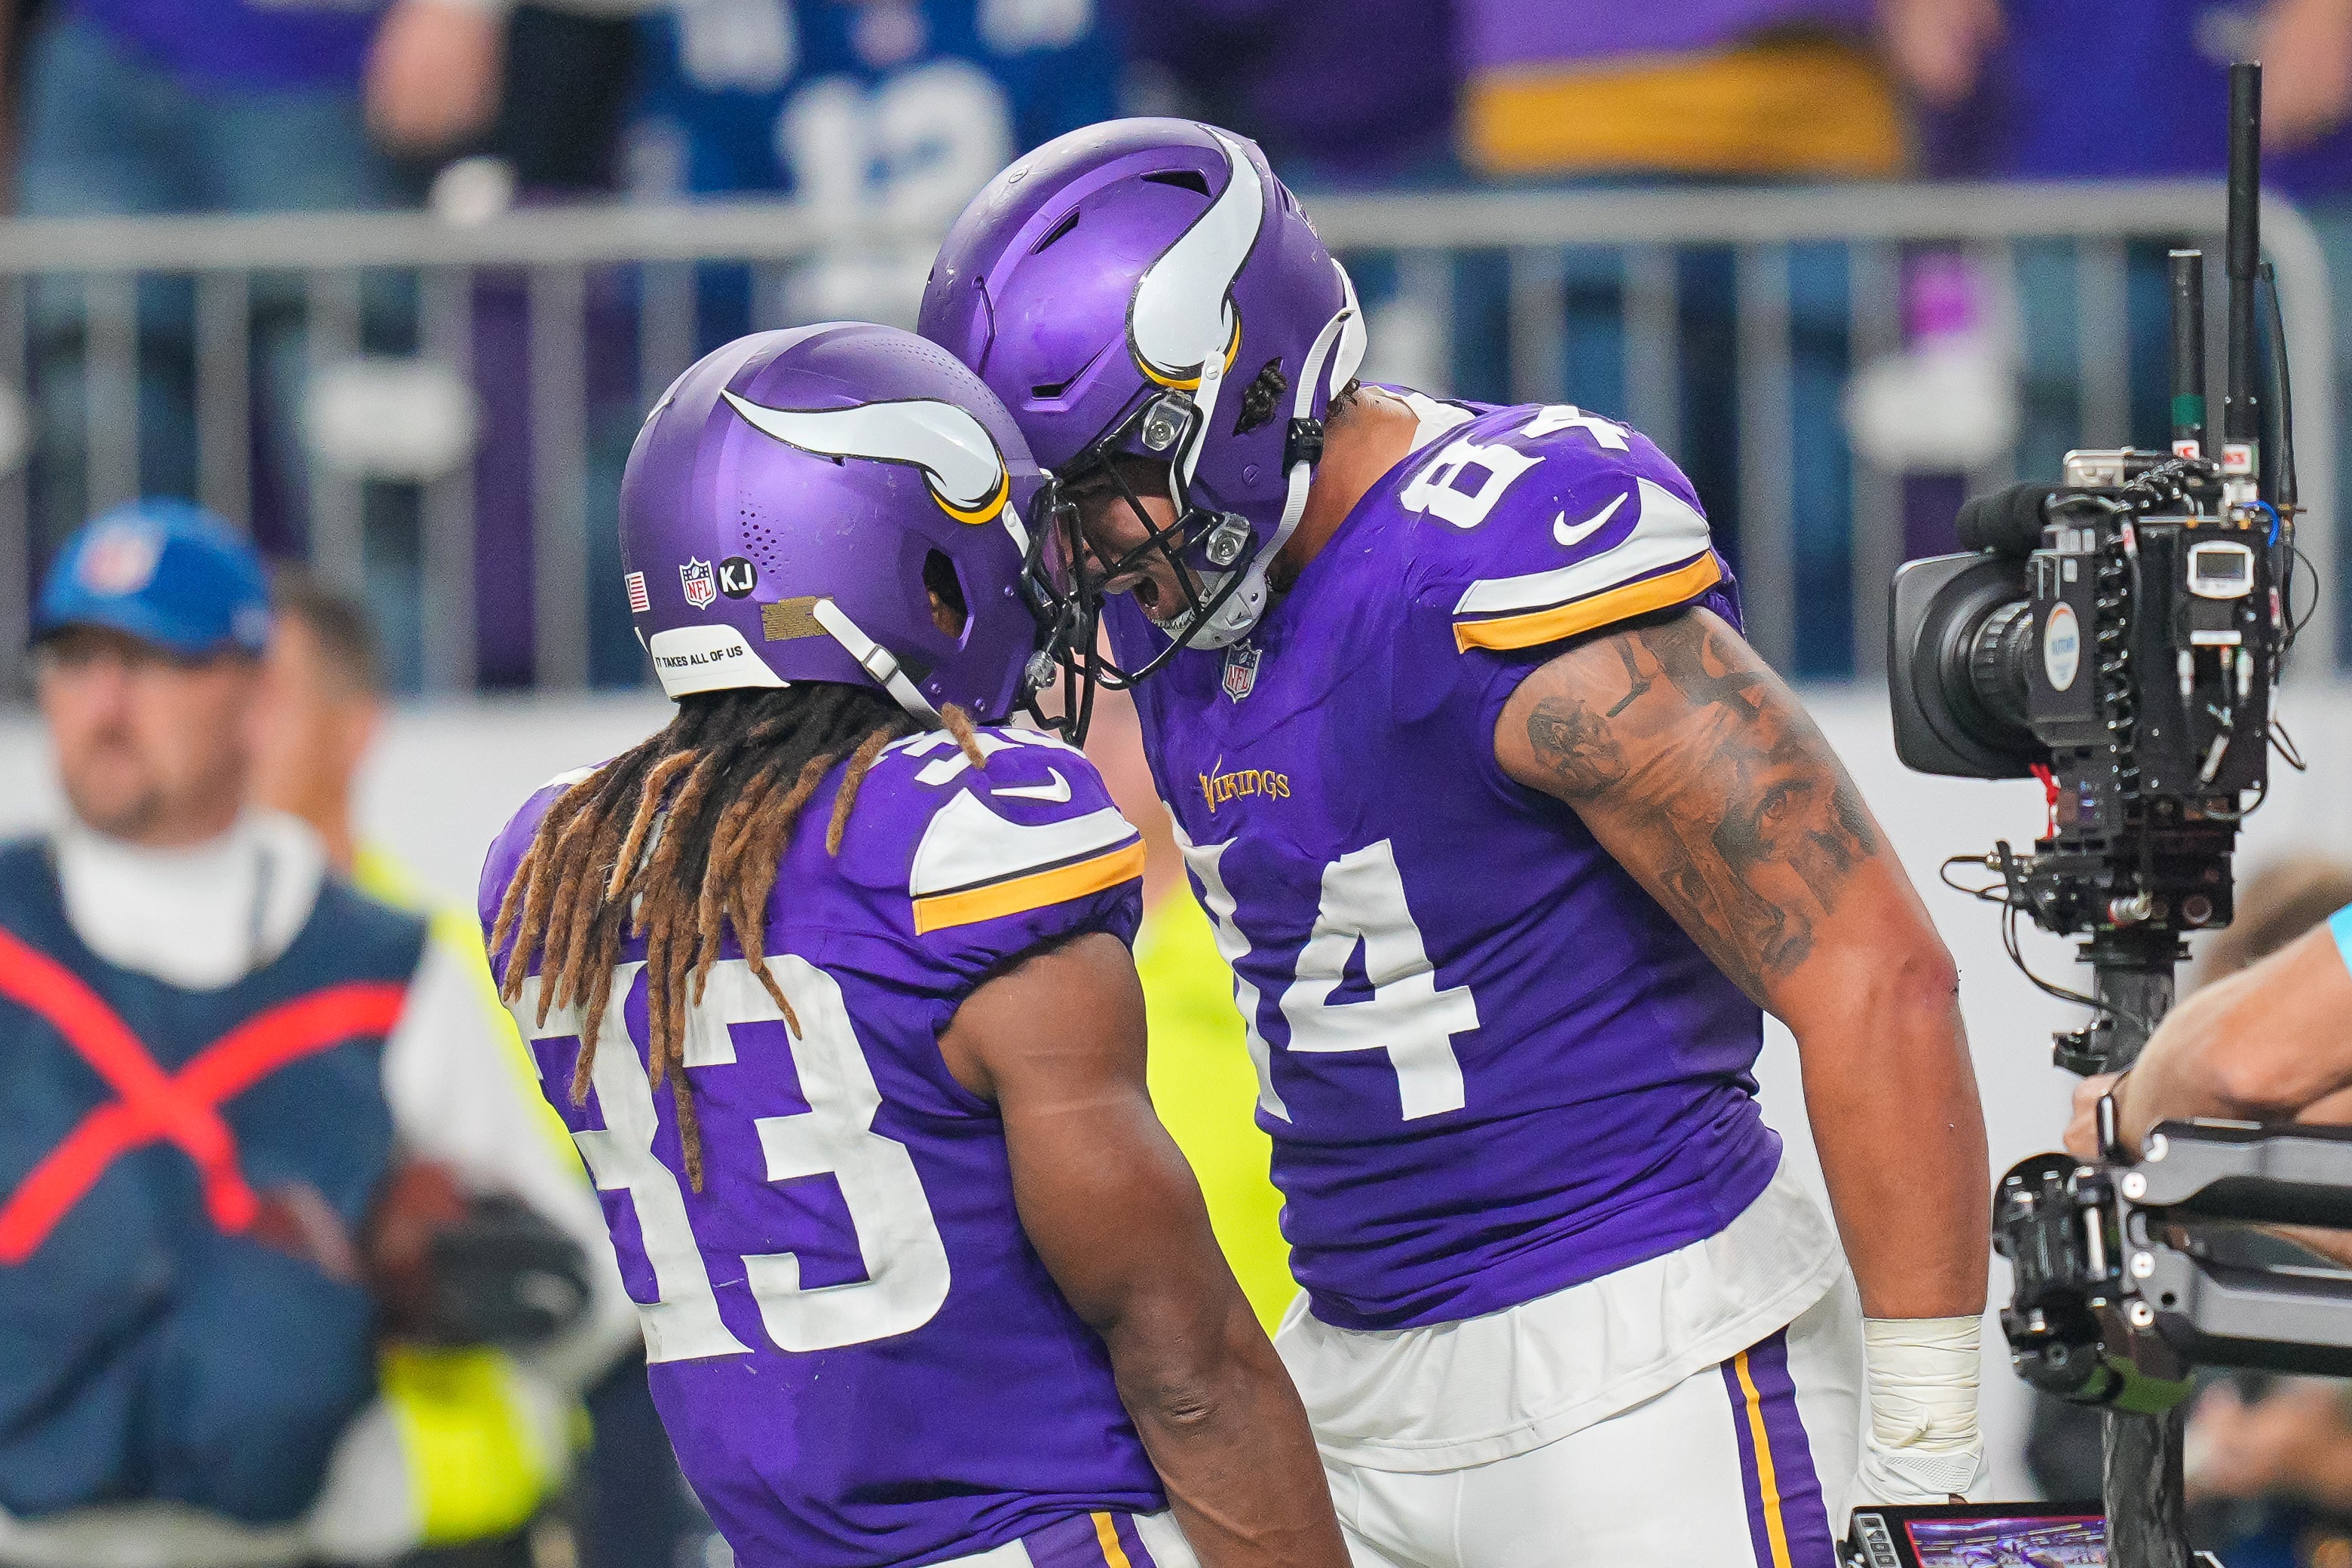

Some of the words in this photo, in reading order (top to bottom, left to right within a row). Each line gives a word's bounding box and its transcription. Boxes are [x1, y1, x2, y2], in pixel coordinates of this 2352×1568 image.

[1400, 405, 1633, 528] 84
[688, 580, 712, 601] NFL
[719, 563, 753, 593] KJ
[654, 657, 663, 668] IT
[663, 656, 688, 668] TAKES
[691, 653, 709, 665] ALL
[709, 650, 724, 662] OF
[726, 645, 743, 658] US
[1227, 666, 1251, 691] NFL
[1199, 754, 1291, 813] VIKINGS
